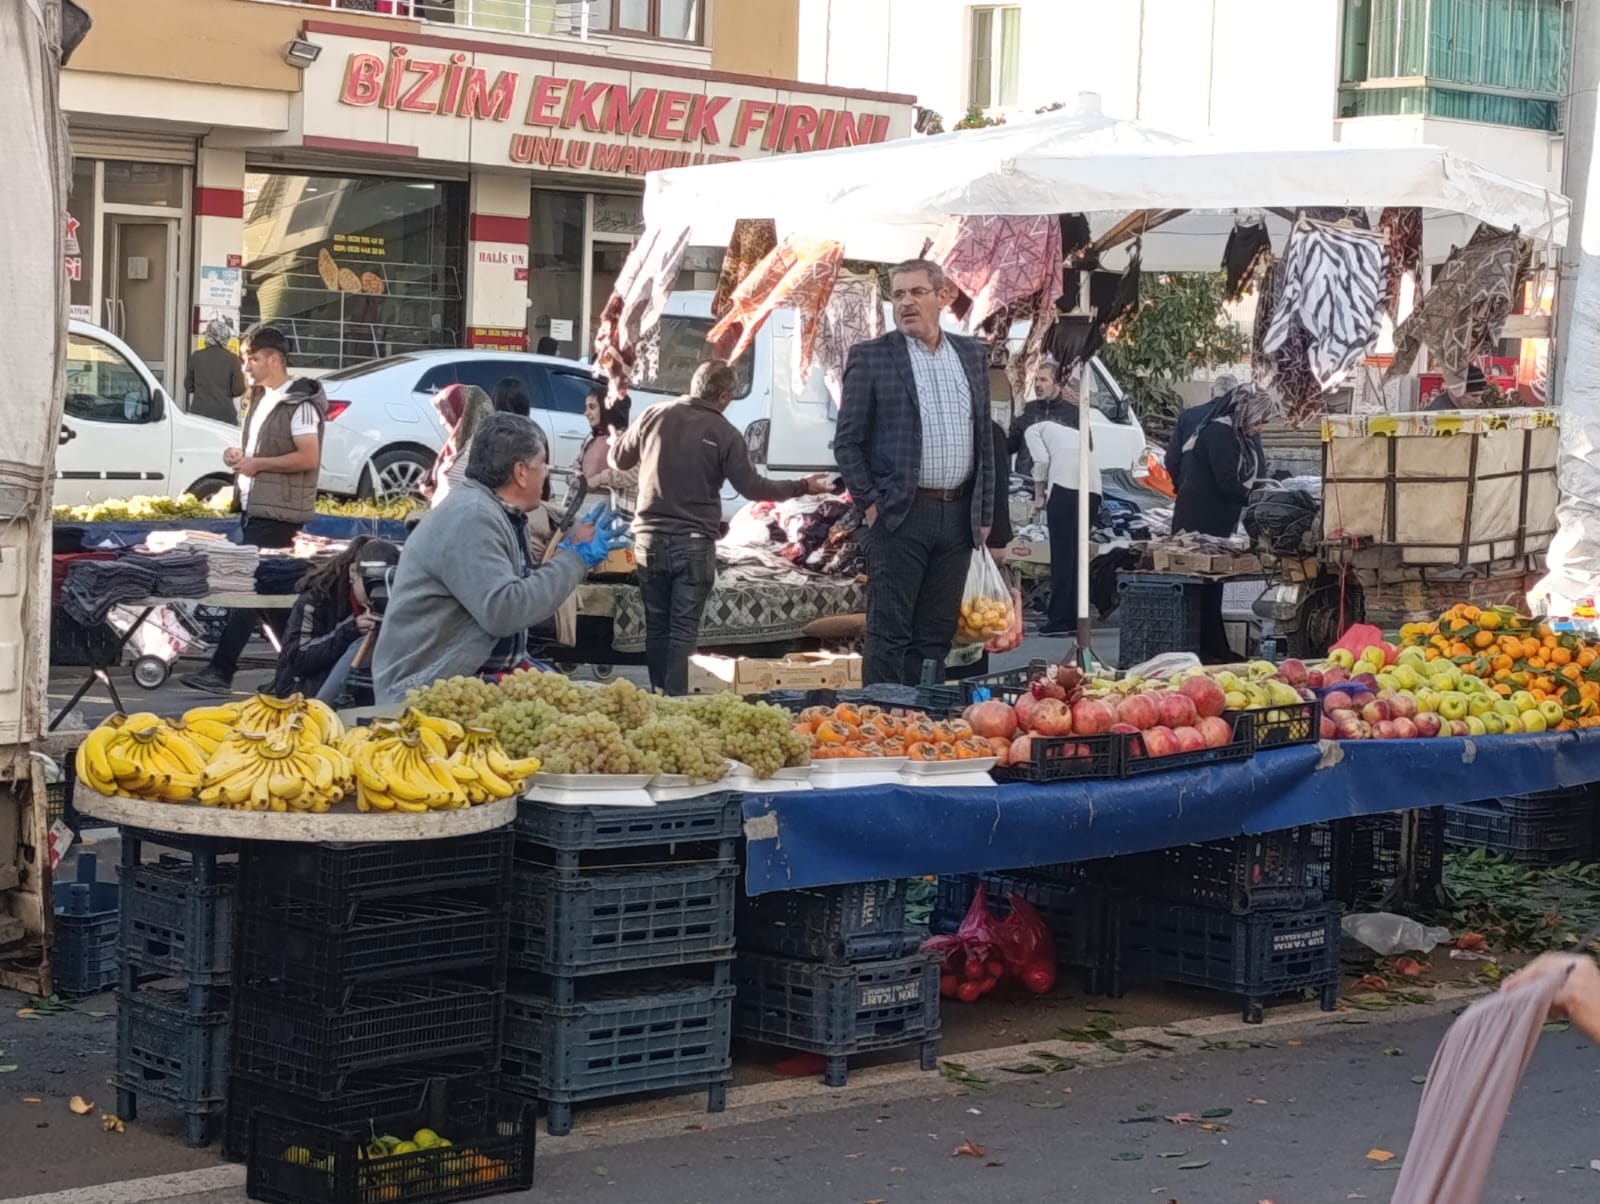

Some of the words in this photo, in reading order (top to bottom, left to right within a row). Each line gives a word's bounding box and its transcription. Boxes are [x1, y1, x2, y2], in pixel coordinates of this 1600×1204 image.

[340, 46, 519, 122] BİZİM
[525, 75, 732, 145] EKMEK
[730, 99, 891, 153] FIRINI
[510, 134, 590, 168] UNLU
